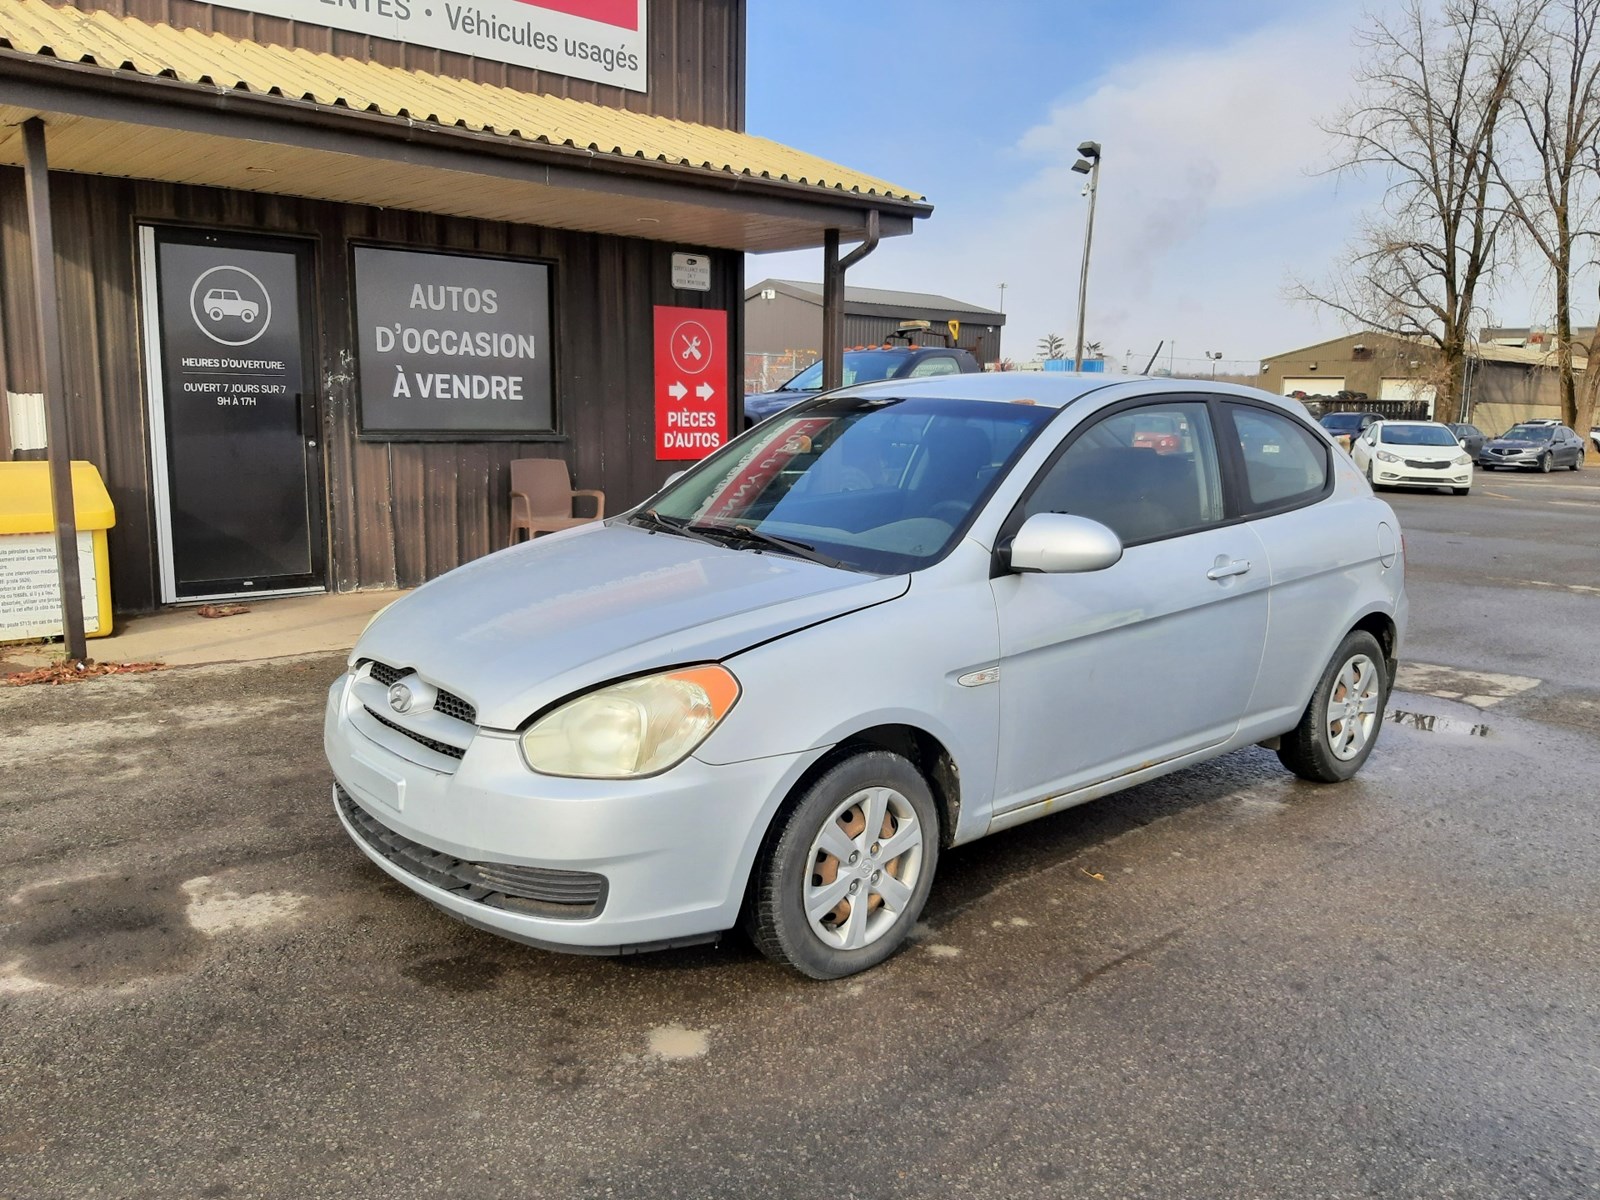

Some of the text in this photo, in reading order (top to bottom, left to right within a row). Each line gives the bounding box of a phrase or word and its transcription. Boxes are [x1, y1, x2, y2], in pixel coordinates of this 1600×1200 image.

[445, 3, 558, 53] Véhicules
[565, 38, 639, 72] usagés
[409, 283, 498, 314] AUTOS
[375, 322, 536, 359] D'OCCASION
[182, 357, 286, 370] HEURES D'OUVERTURE:
[183, 382, 287, 394] OUVERT 7 JOURS SUR 7
[393, 365, 524, 401] À VENDRE
[217, 394, 257, 406] 9H À 17H
[667, 408, 716, 428] PIÈCES
[663, 432, 720, 448] D'AUTOS
